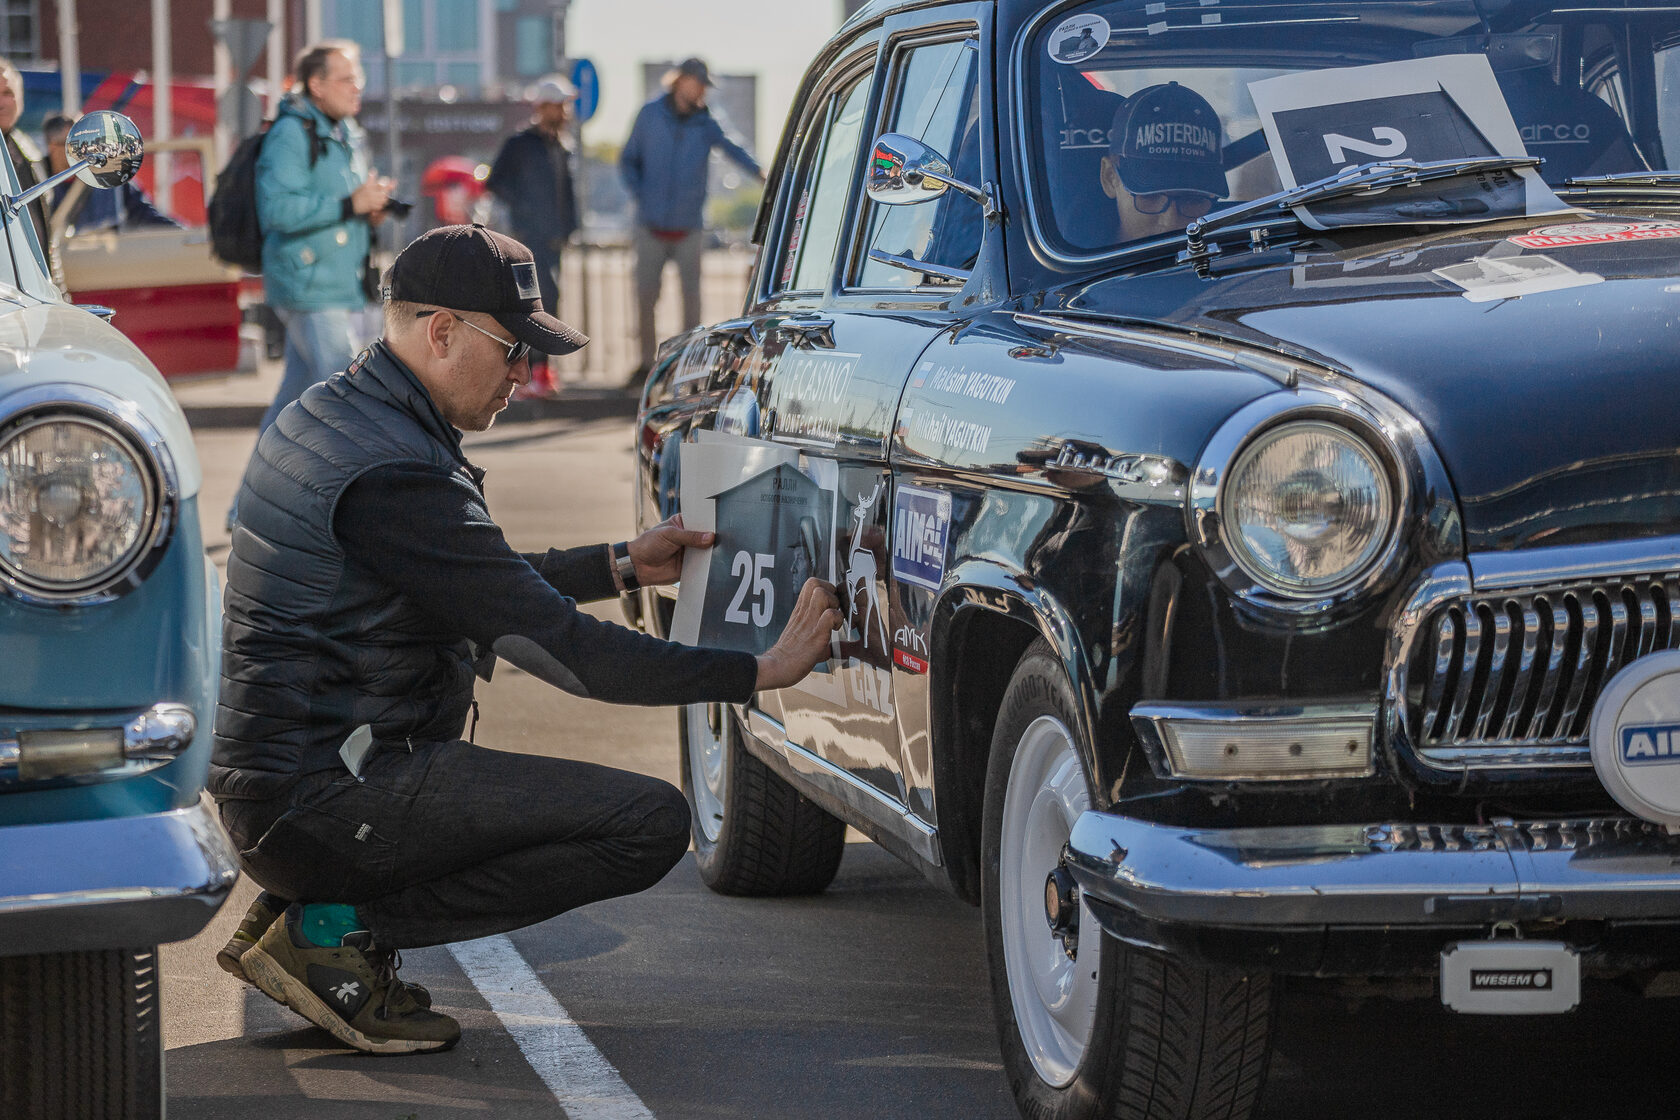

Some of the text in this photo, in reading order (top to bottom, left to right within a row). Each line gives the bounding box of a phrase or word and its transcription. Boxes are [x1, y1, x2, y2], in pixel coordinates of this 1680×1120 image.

[1136, 123, 1216, 152] AMSTERDAM
[797, 360, 851, 404] CASINO
[929, 365, 1016, 404] Maksim YAGUTKIN
[943, 419, 992, 454] YAGUTKIN
[725, 550, 775, 627] 25
[849, 655, 893, 717] GAZ
[1475, 974, 1532, 986] WESEM
